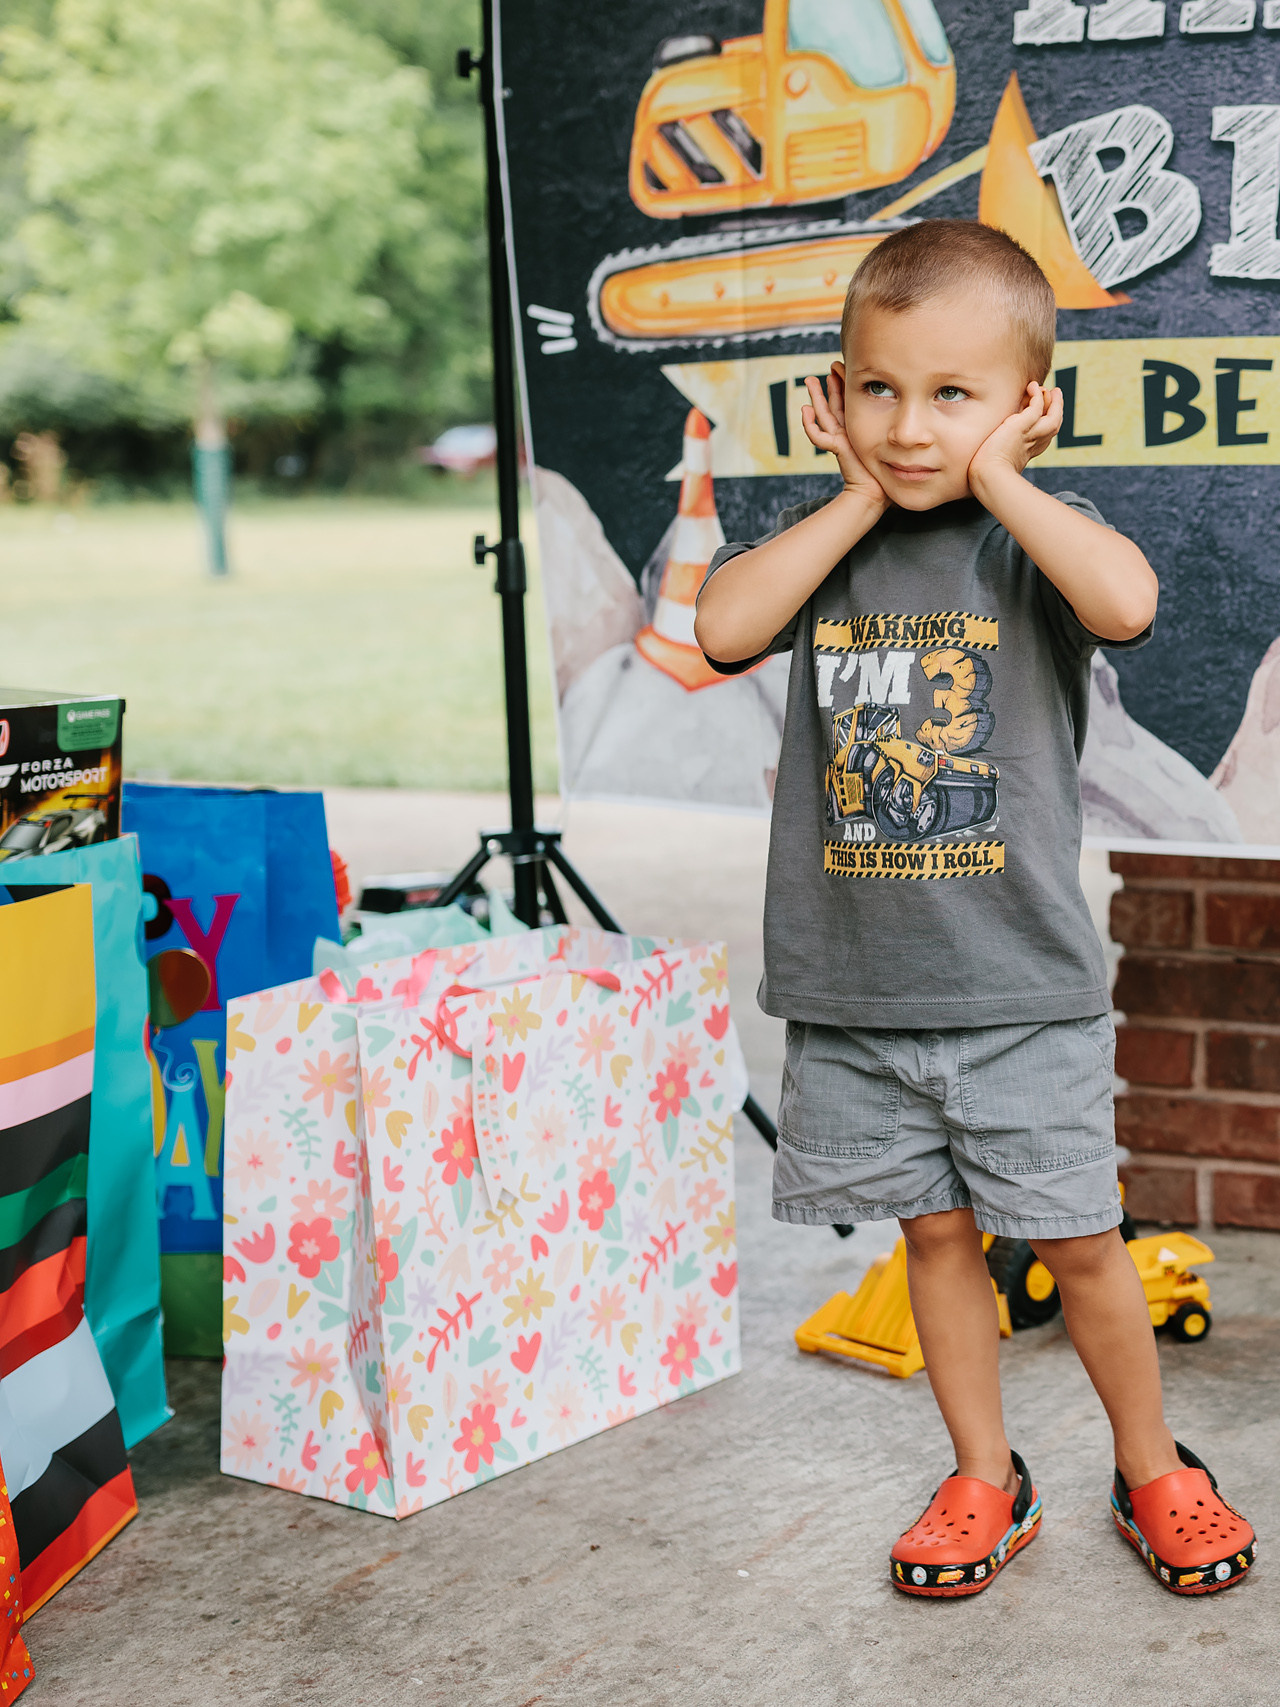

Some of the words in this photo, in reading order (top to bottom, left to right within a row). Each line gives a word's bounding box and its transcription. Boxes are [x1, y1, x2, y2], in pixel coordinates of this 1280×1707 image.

[1143, 357, 1273, 448] BE
[850, 617, 967, 645] WARNING
[816, 651, 917, 708] I'M
[915, 647, 996, 756] 3
[20, 766, 108, 794] MOTORSPORT
[21, 757, 74, 775] FORZA
[843, 823, 877, 842] AND
[830, 850, 857, 869] THIS
[859, 851, 878, 869] IS
[881, 852, 926, 871] HOW
[931, 853, 939, 870] I
[943, 850, 994, 870] ROLL
